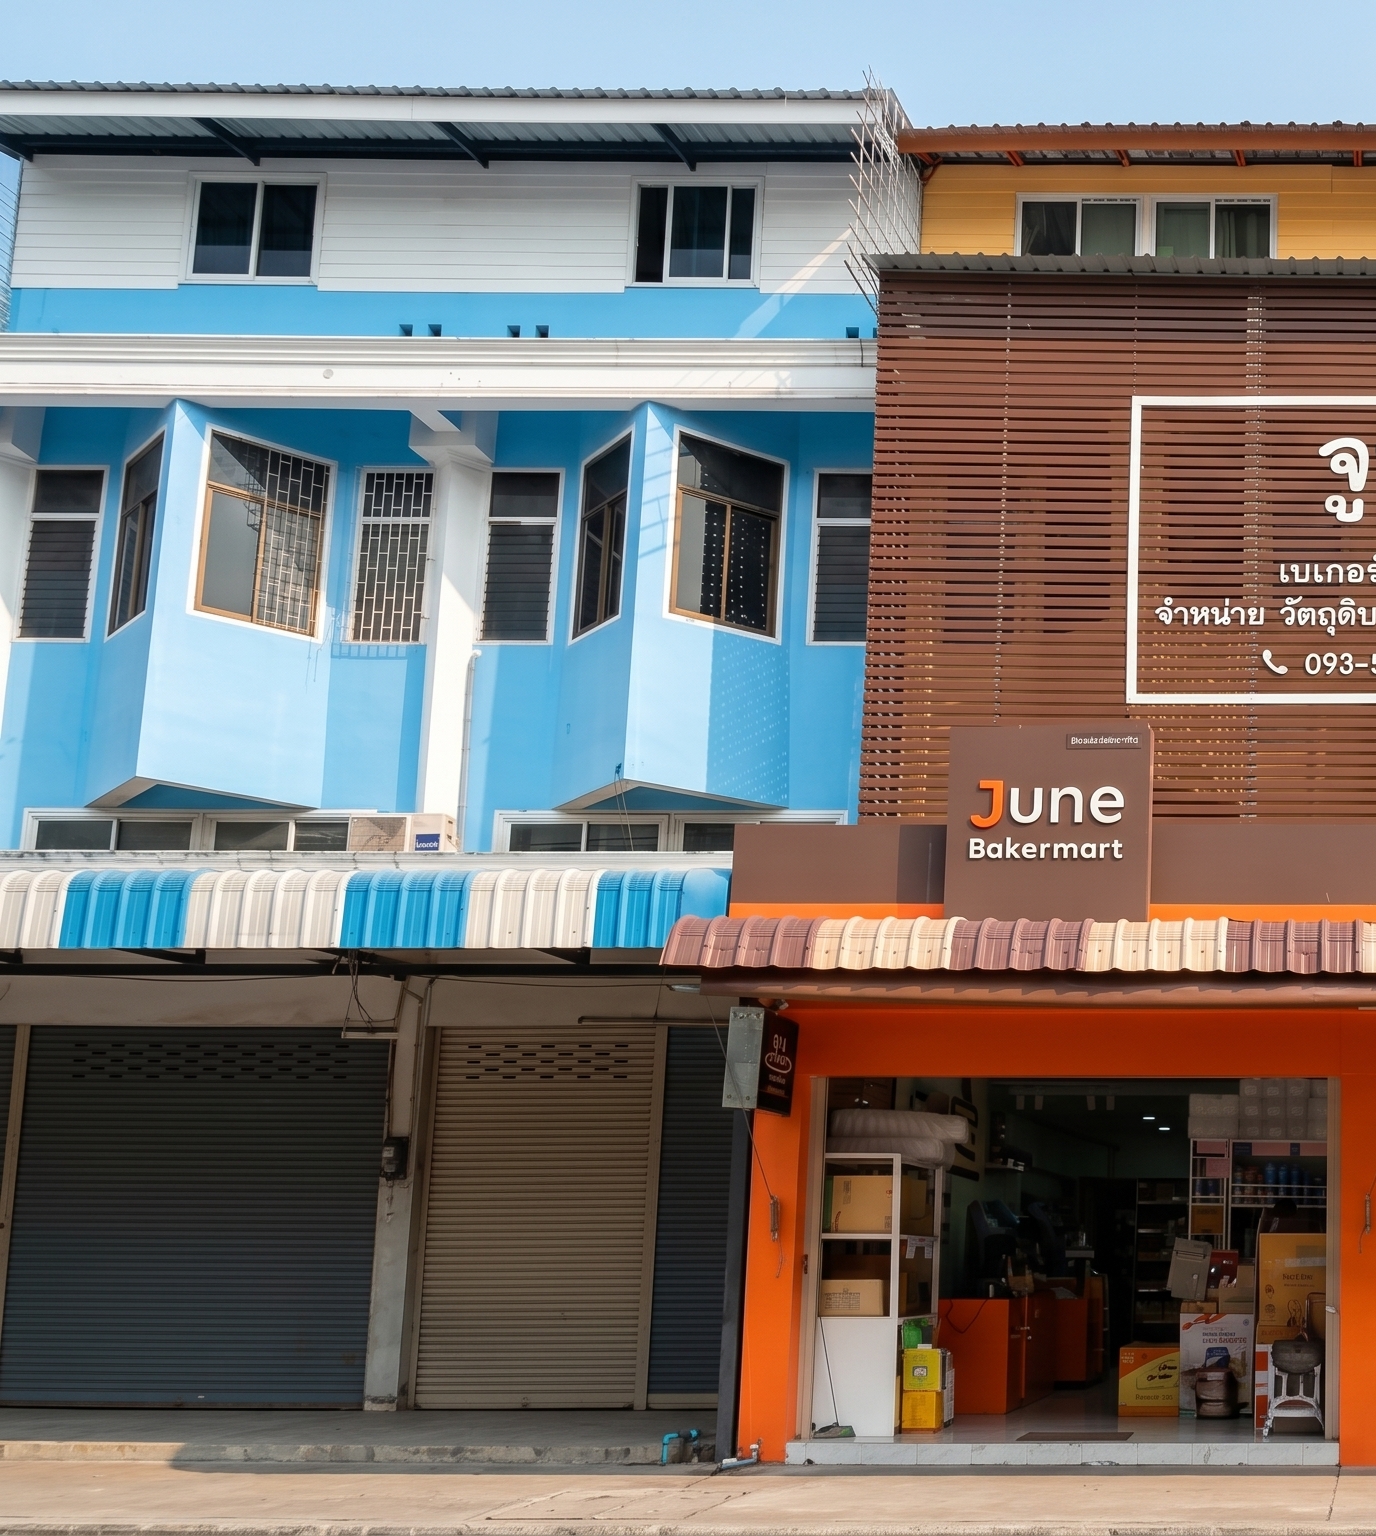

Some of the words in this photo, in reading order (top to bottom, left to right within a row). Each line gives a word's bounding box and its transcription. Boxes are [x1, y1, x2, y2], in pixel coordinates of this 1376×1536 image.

[1154, 597, 1265, 626] จำหน่าย
[970, 780, 1125, 828] June
[968, 837, 1123, 859] Bakermart
